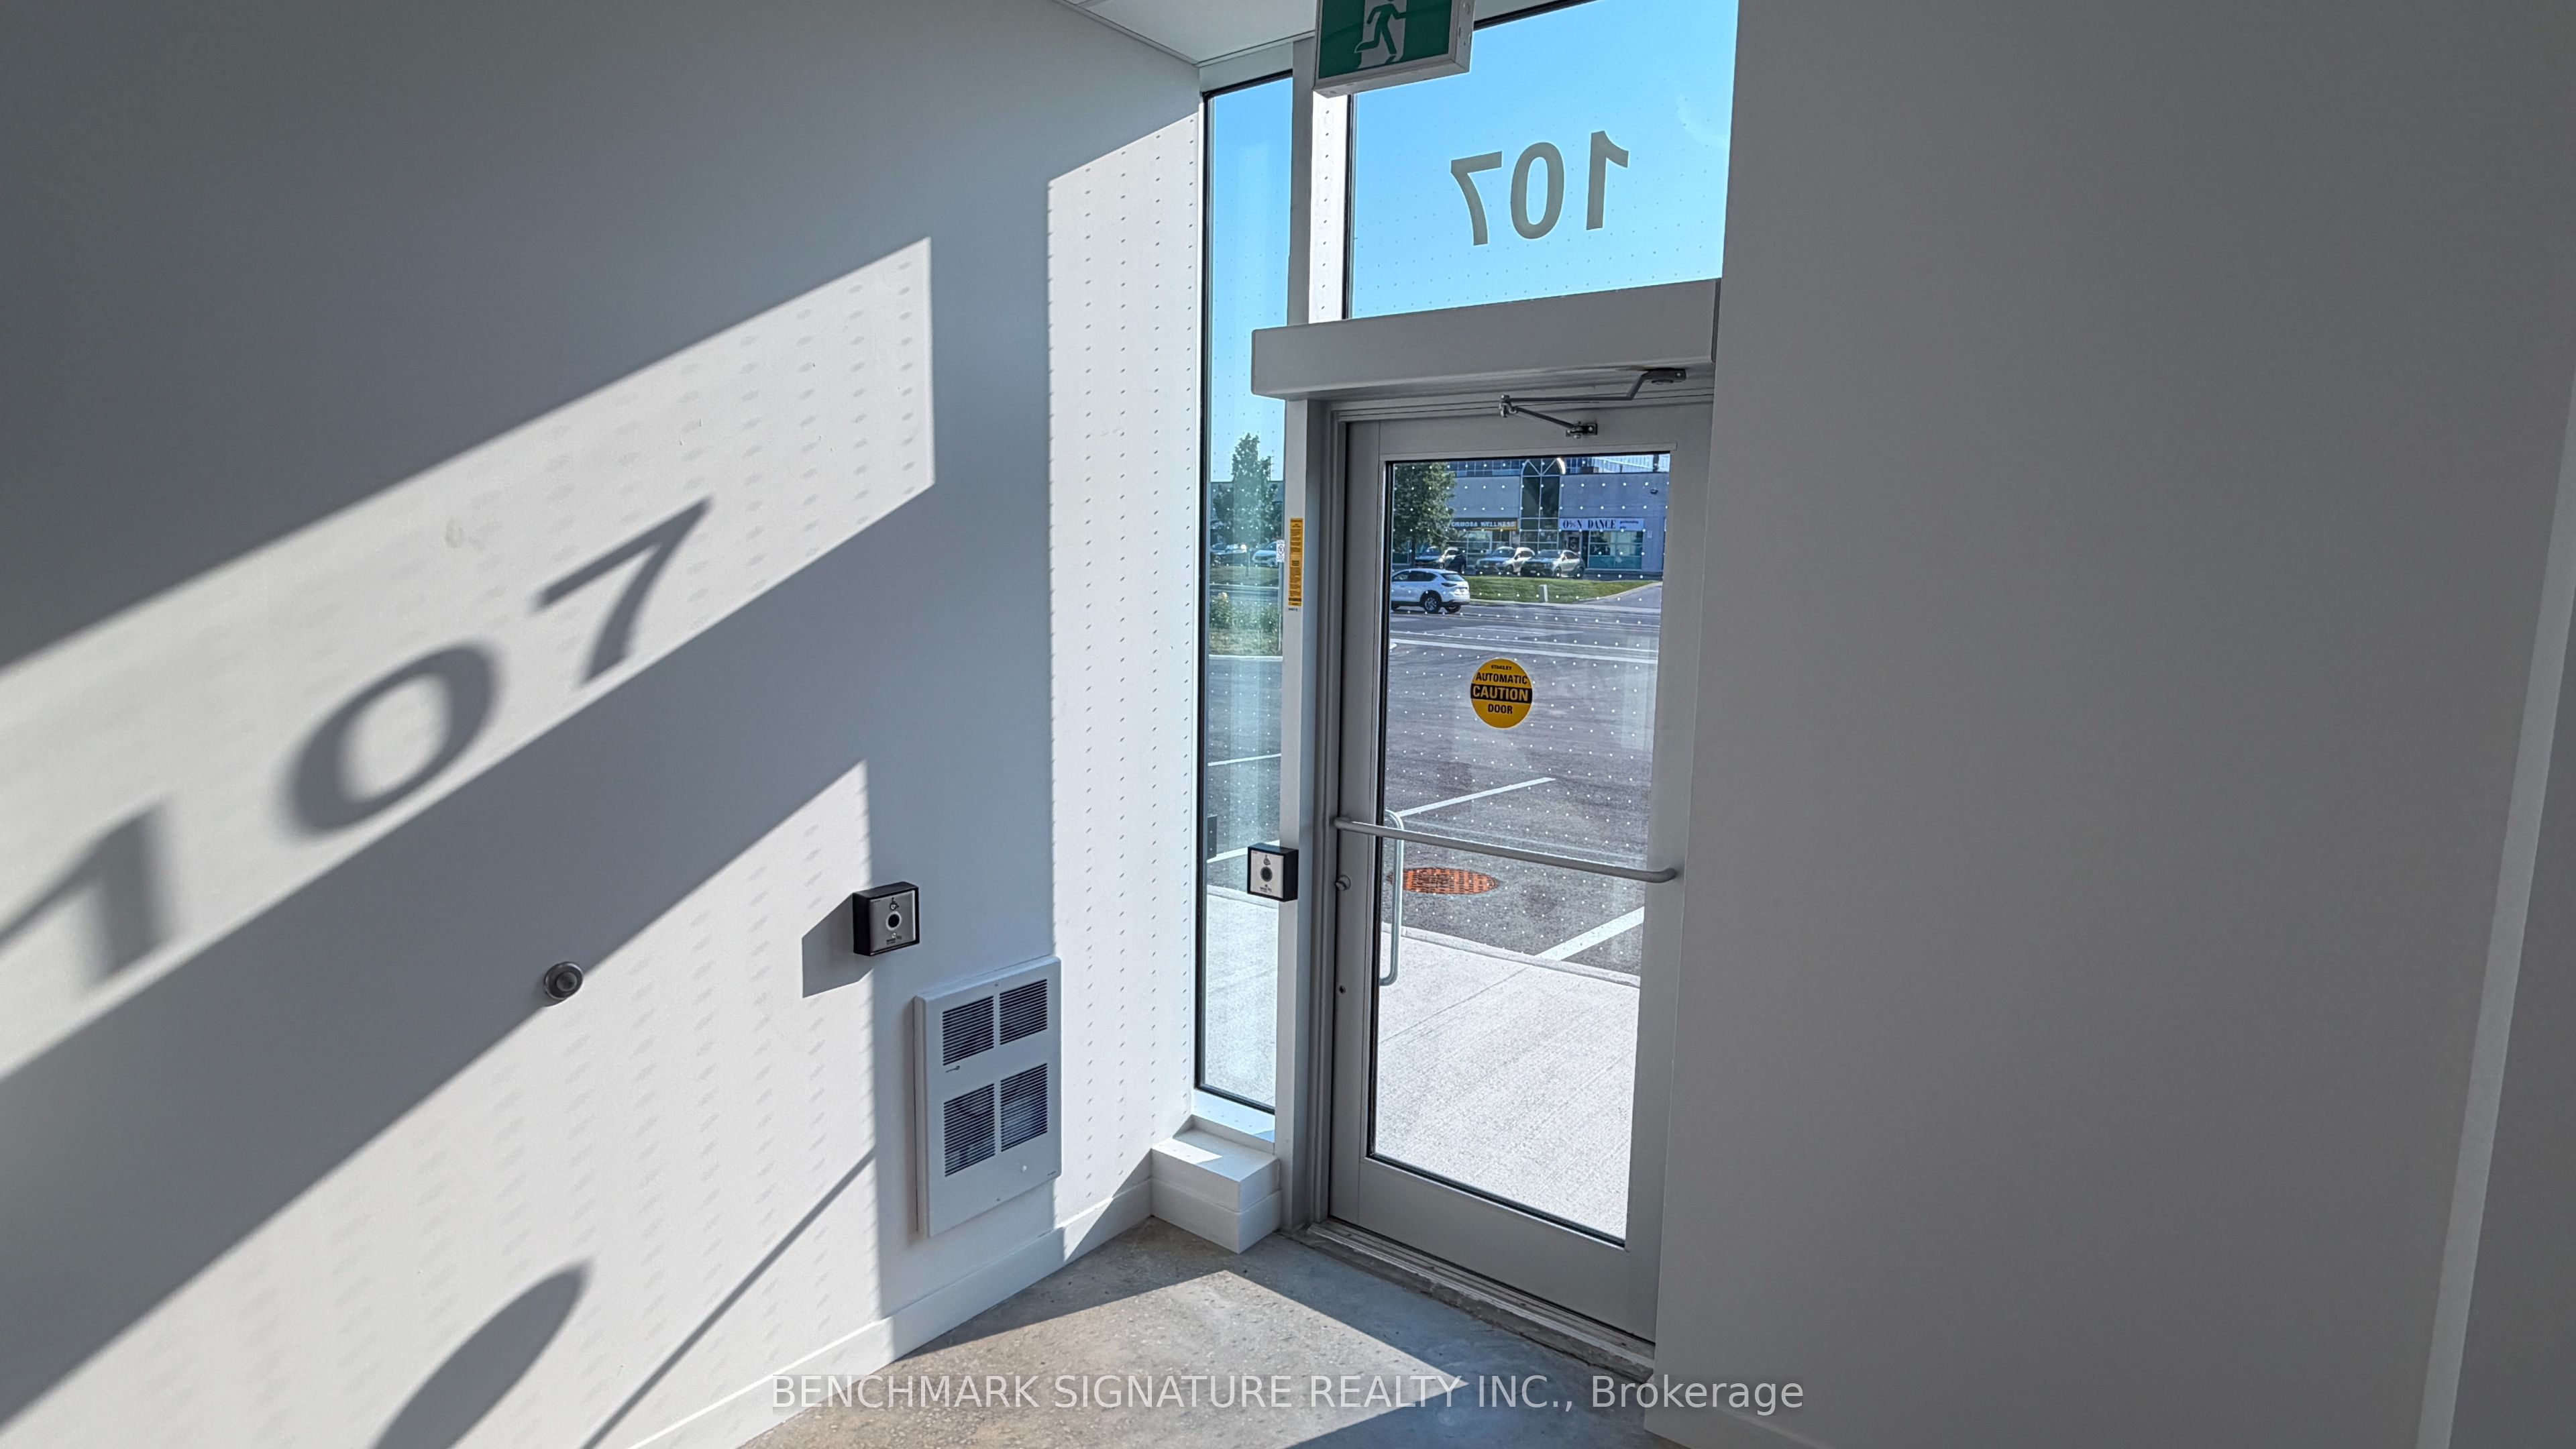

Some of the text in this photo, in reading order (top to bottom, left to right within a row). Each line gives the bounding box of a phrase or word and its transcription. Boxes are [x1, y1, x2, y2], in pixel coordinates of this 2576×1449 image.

[1588, 519, 1616, 529] DANCE
[1476, 672, 1528, 685] AUTOMATIC
[1472, 686, 1529, 702] CAUTION
[1487, 704, 1513, 714] DOOR
